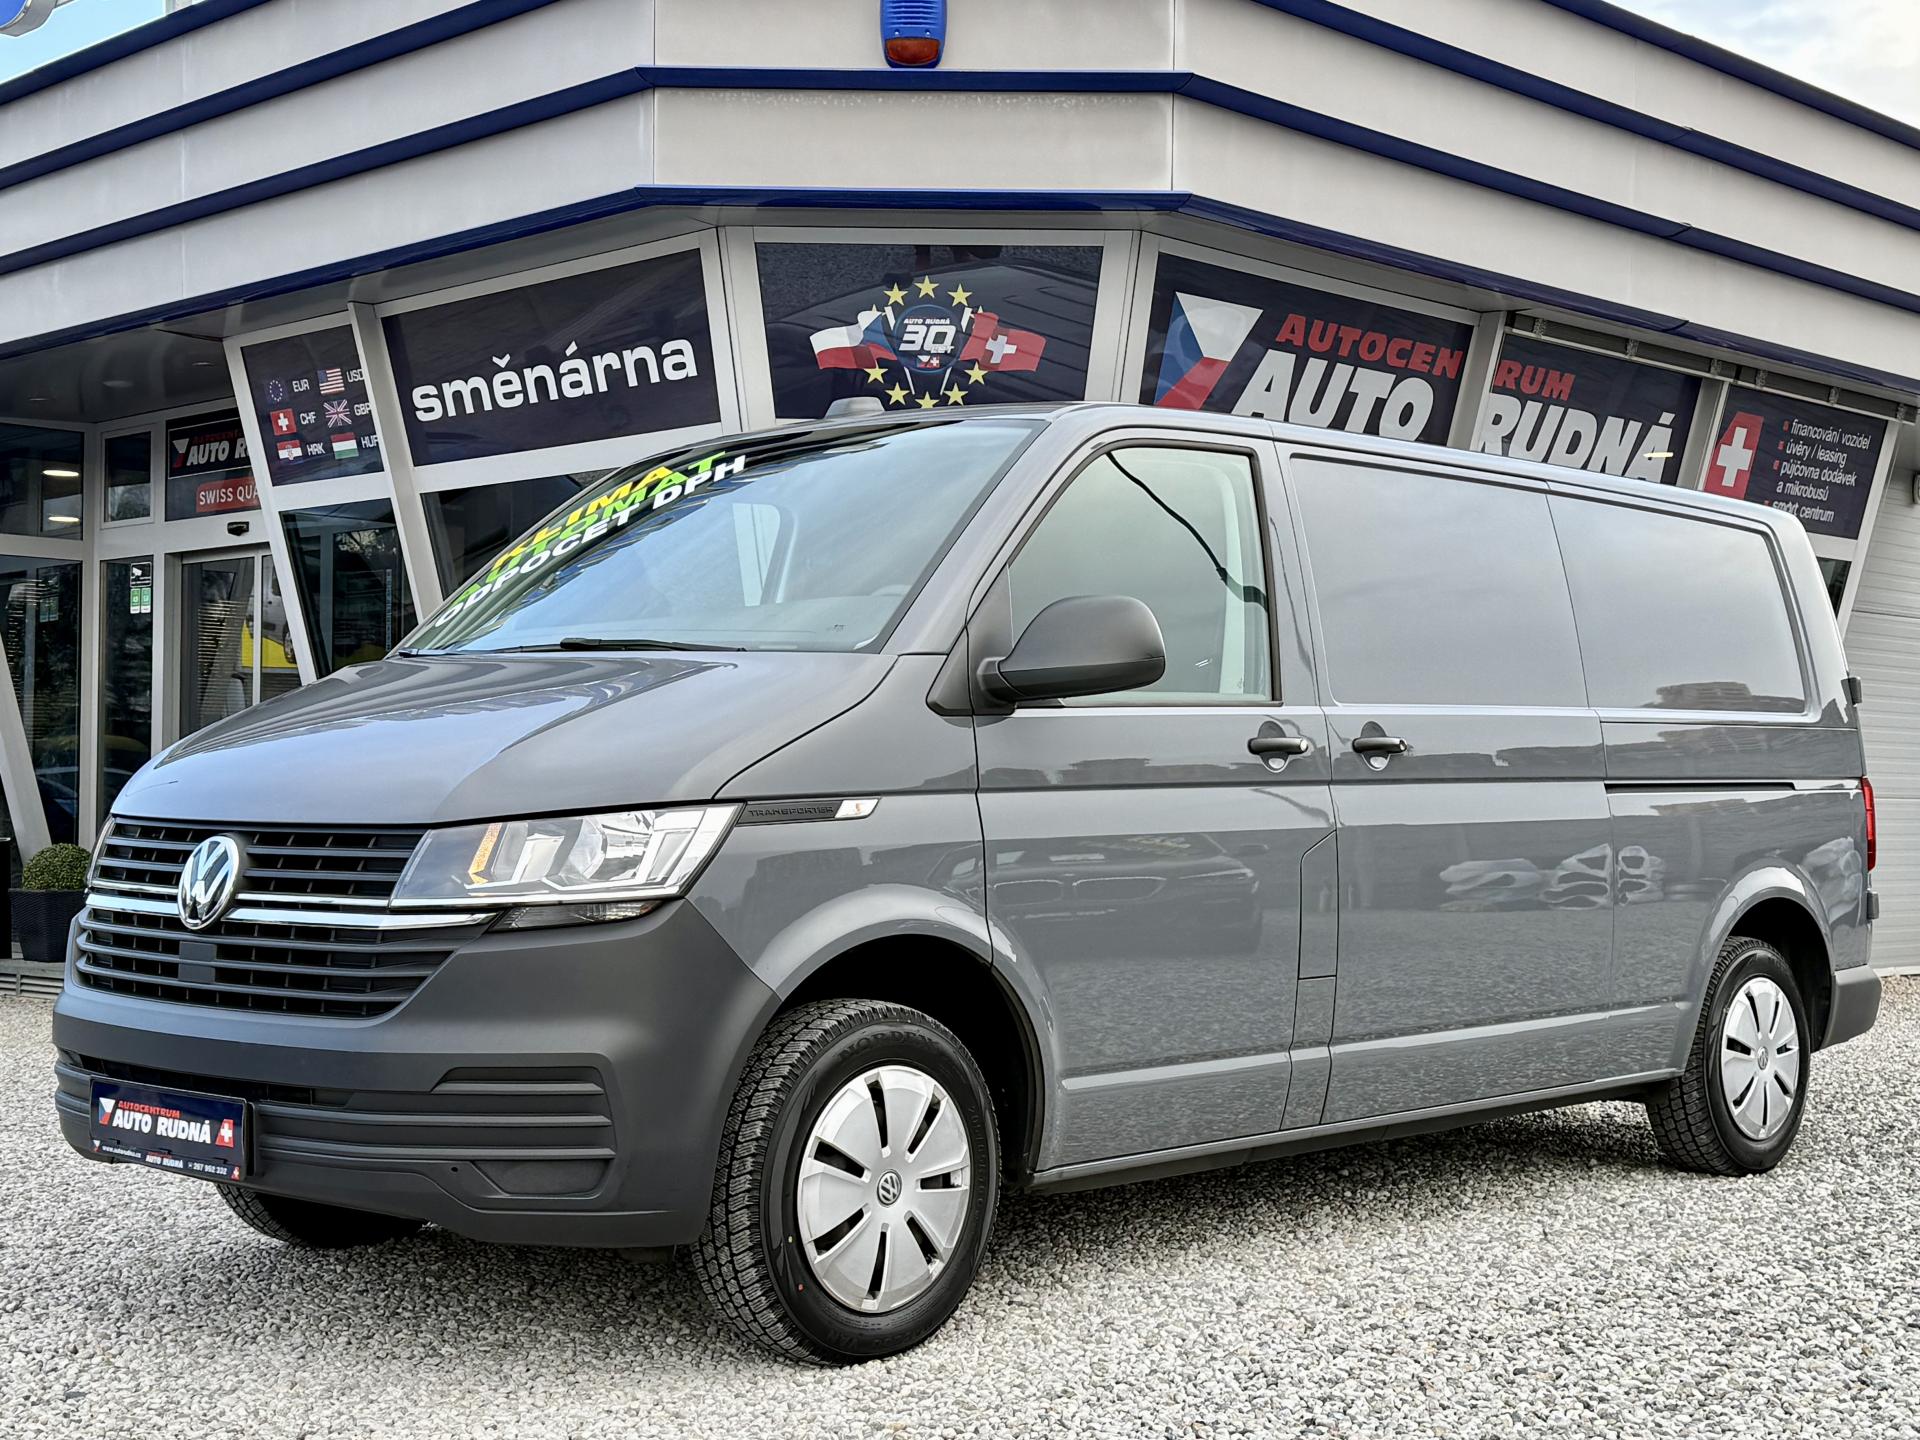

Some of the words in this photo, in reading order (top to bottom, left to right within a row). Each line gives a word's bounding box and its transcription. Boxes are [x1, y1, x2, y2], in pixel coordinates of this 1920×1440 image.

[899, 325, 956, 351] 30
[1276, 313, 1463, 379] AUTOCEN
[346, 368, 364, 383] USD
[411, 339, 698, 422] směnárna
[292, 379, 310, 393] EUR
[299, 411, 317, 425] CHF
[353, 403, 371, 416] GBP
[1230, 348, 1434, 442] AUTO
[1479, 392, 1676, 484] RUDNÁ
[361, 434, 379, 449] HUF
[1791, 418, 1841, 444] financování
[1842, 432, 1871, 450] vozidel
[186, 440, 230, 466] AUTO
[306, 442, 326, 456] HRK
[1786, 438, 1811, 461] úvěry
[1817, 444, 1847, 468] leasing
[1780, 459, 1820, 479] půjčovna
[1820, 466, 1857, 487] dodávek
[200, 487, 233, 505] SWISS
[1776, 481, 1784, 493] a
[1799, 505, 1835, 523] centrum
[434, 502, 640, 628] ODPOCET
[652, 454, 747, 510] DPH
[749, 806, 834, 817] TRANSPORTER
[118, 1101, 181, 1119] AUTOCENTRUM
[112, 1108, 152, 1134] AUTO
[156, 1115, 212, 1144] RUDNÁ
